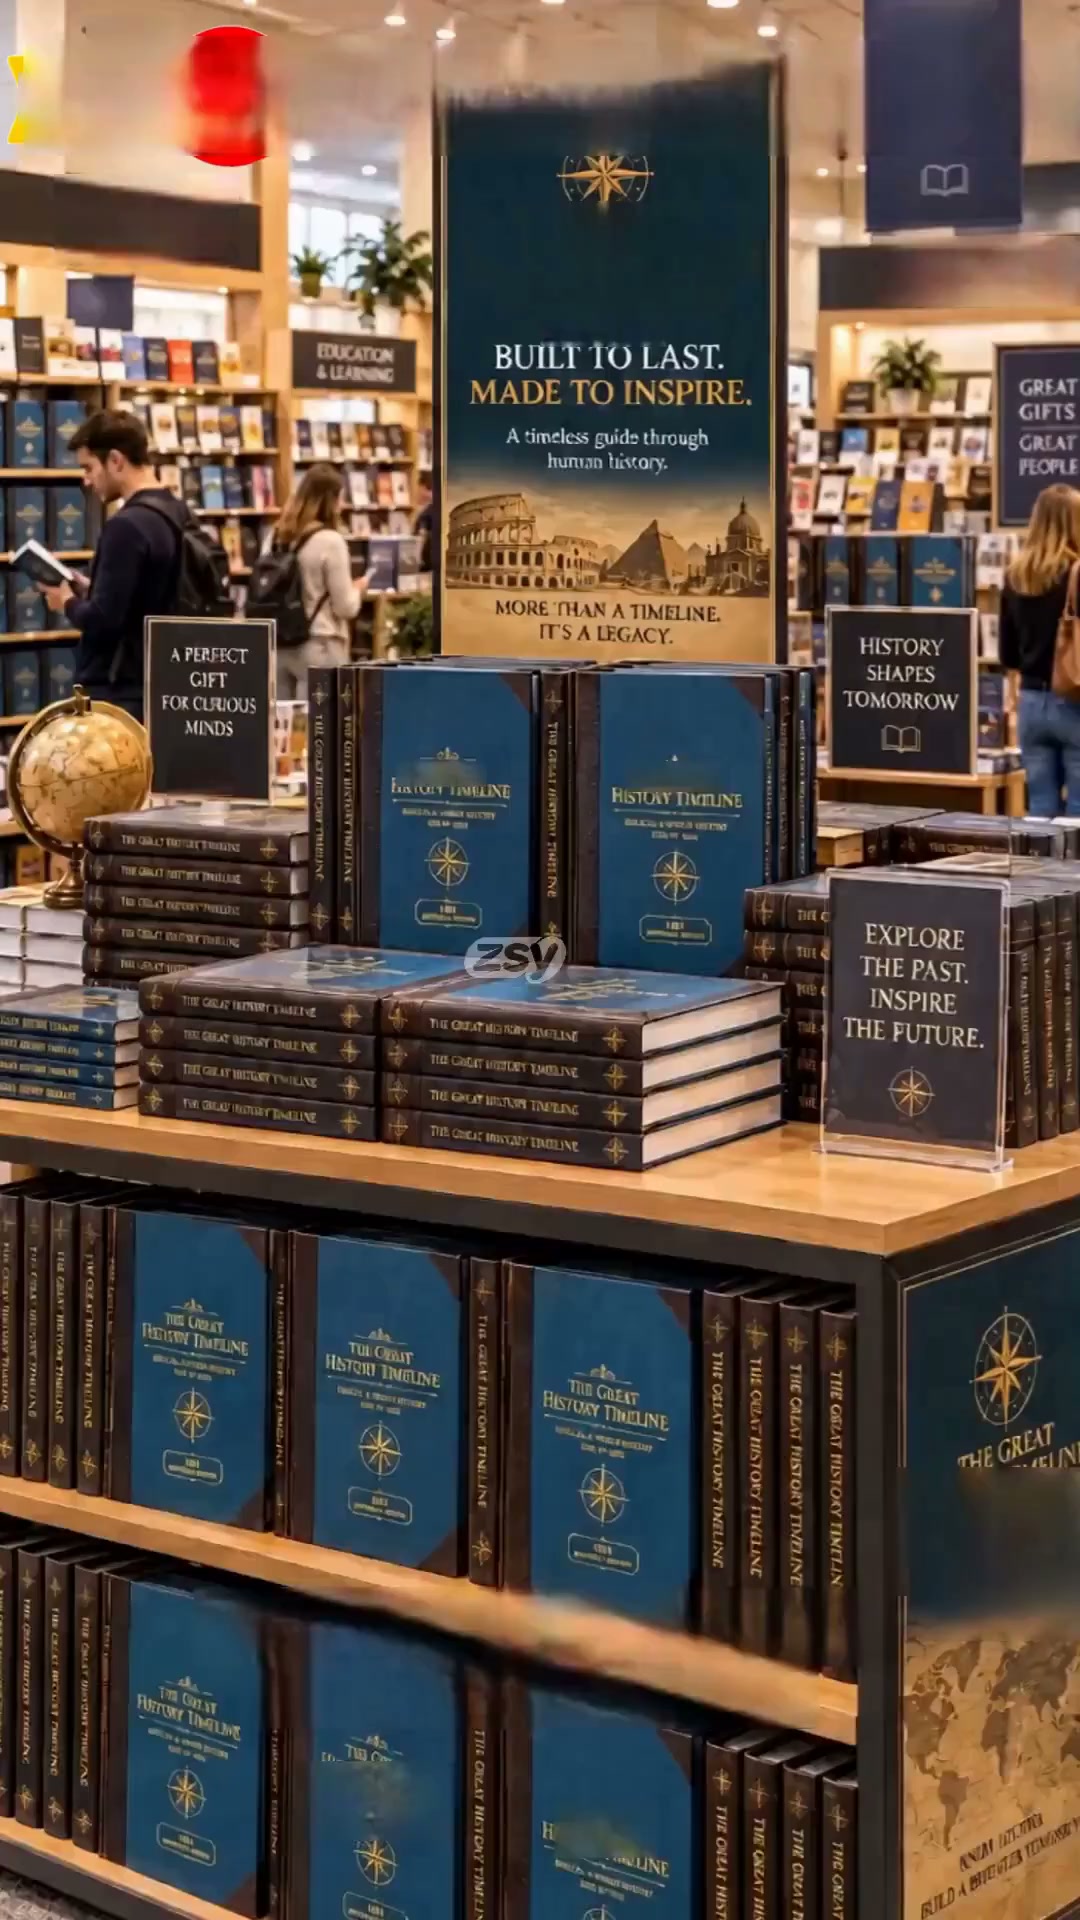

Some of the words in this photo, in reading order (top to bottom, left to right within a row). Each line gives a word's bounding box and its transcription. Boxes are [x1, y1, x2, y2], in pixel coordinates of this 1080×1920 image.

[317, 342, 394, 363] EDUCATION
[495, 343, 580, 370] BUILT
[589, 343, 632, 370] TO
[642, 343, 724, 370] LAST.
[316, 364, 328, 379] &
[330, 364, 394, 383] LEARNING
[470, 379, 561, 405] MADE
[570, 379, 614, 405] TO
[624, 379, 752, 406] INSPIRE.
[1019, 378, 1077, 397] GREAT
[1019, 403, 1075, 420] GIFTS
[506, 429, 520, 444] A
[525, 428, 589, 445] timeless
[595, 430, 639, 449] guide
[644, 429, 709, 450] through
[1019, 434, 1077, 451] GREAT
[548, 453, 603, 470] human
[608, 452, 668, 475] history.
[1019, 458, 1078, 476] PEOPLE
[496, 600, 549, 616] MORE
[553, 601, 606, 619] THAN
[612, 603, 625, 619] A
[630, 603, 721, 622] TIMELINE.
[540, 624, 572, 640] IT'S
[577, 625, 591, 641] A
[597, 626, 673, 645] LEGACY.
[170, 648, 180, 663] A
[185, 647, 249, 664] PERFECT
[860, 637, 944, 657] HISTORY
[190, 672, 227, 688] GIFT
[866, 664, 936, 683] SHAPES
[162, 695, 189, 711] FOR
[193, 695, 256, 714] CURIOUS
[843, 691, 959, 711] TOMORROW
[185, 720, 233, 736] MINDS
[865, 922, 965, 951] EXPLORE
[860, 956, 904, 978] THE
[911, 959, 969, 984] PAST.
[870, 988, 957, 1014] INSPIRE
[843, 1017, 885, 1040] THE
[893, 1022, 984, 1048] FUTURE.
[998, 1422, 1055, 1463] GREAT
[830, 1522, 843, 1588] TIMELIN
